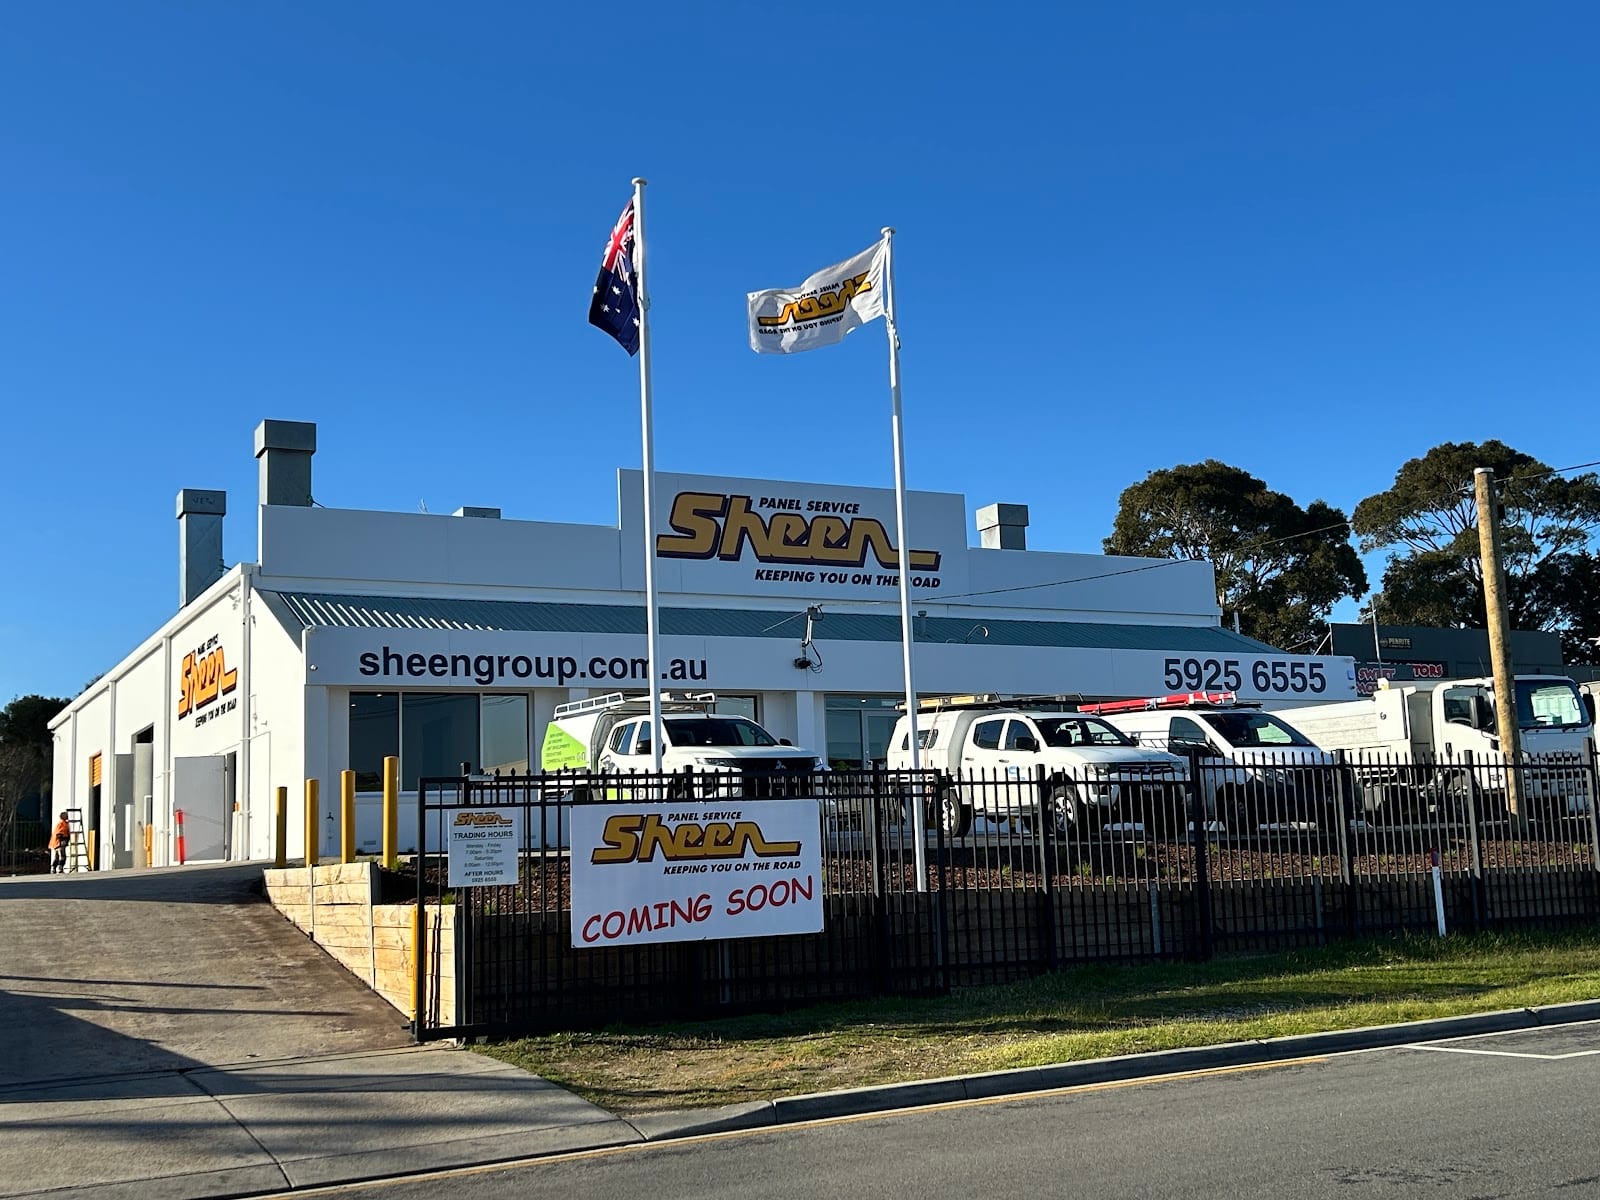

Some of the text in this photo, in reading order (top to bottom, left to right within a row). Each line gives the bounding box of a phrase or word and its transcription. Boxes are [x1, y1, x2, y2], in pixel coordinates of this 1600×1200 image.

[758, 497, 860, 515] PANEL SERVICE
[656, 491, 941, 571] Sheen
[755, 569, 941, 588] KEEPING YOU ON THE OAD
[359, 646, 707, 685] sheengroup.com.au
[1164, 658, 1326, 693] 5925 6555
[667, 811, 742, 821] PANEL SERVICE
[591, 813, 802, 865] Sheen
[663, 861, 801, 875] KEEPING YOU ON THE ROAD
[582, 875, 813, 943] COMING SOON
